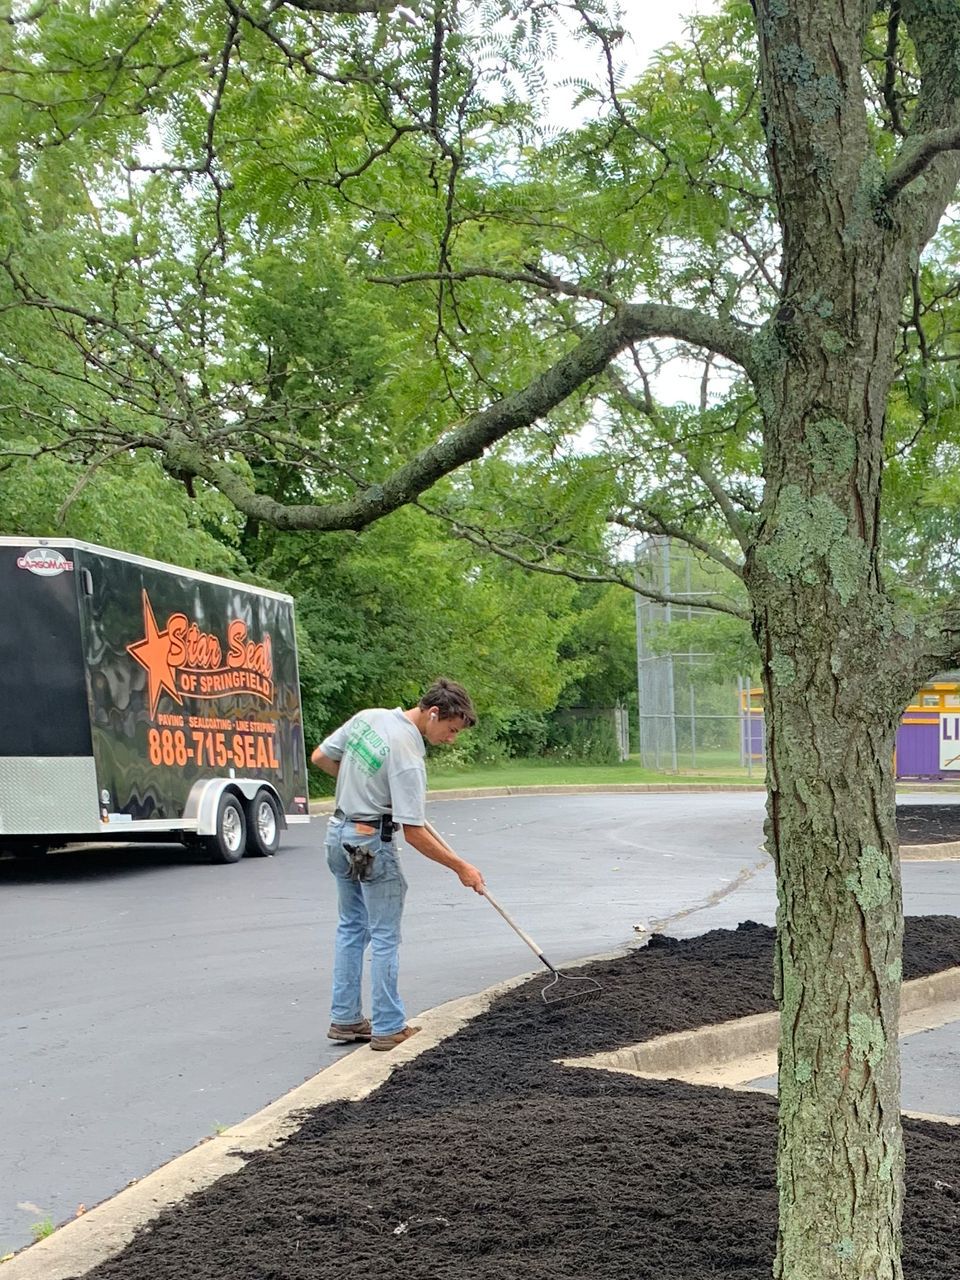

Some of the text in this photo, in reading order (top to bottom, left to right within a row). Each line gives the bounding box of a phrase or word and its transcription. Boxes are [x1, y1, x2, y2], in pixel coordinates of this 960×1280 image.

[167, 613, 273, 681] Star Seal
[181, 671, 270, 696] OF SPRINGFIELD
[157, 714, 184, 727] PAVING
[188, 716, 232, 731] SEALCOATING
[236, 720, 250, 732] LINE
[148, 728, 280, 768] 888-715-SEAL
